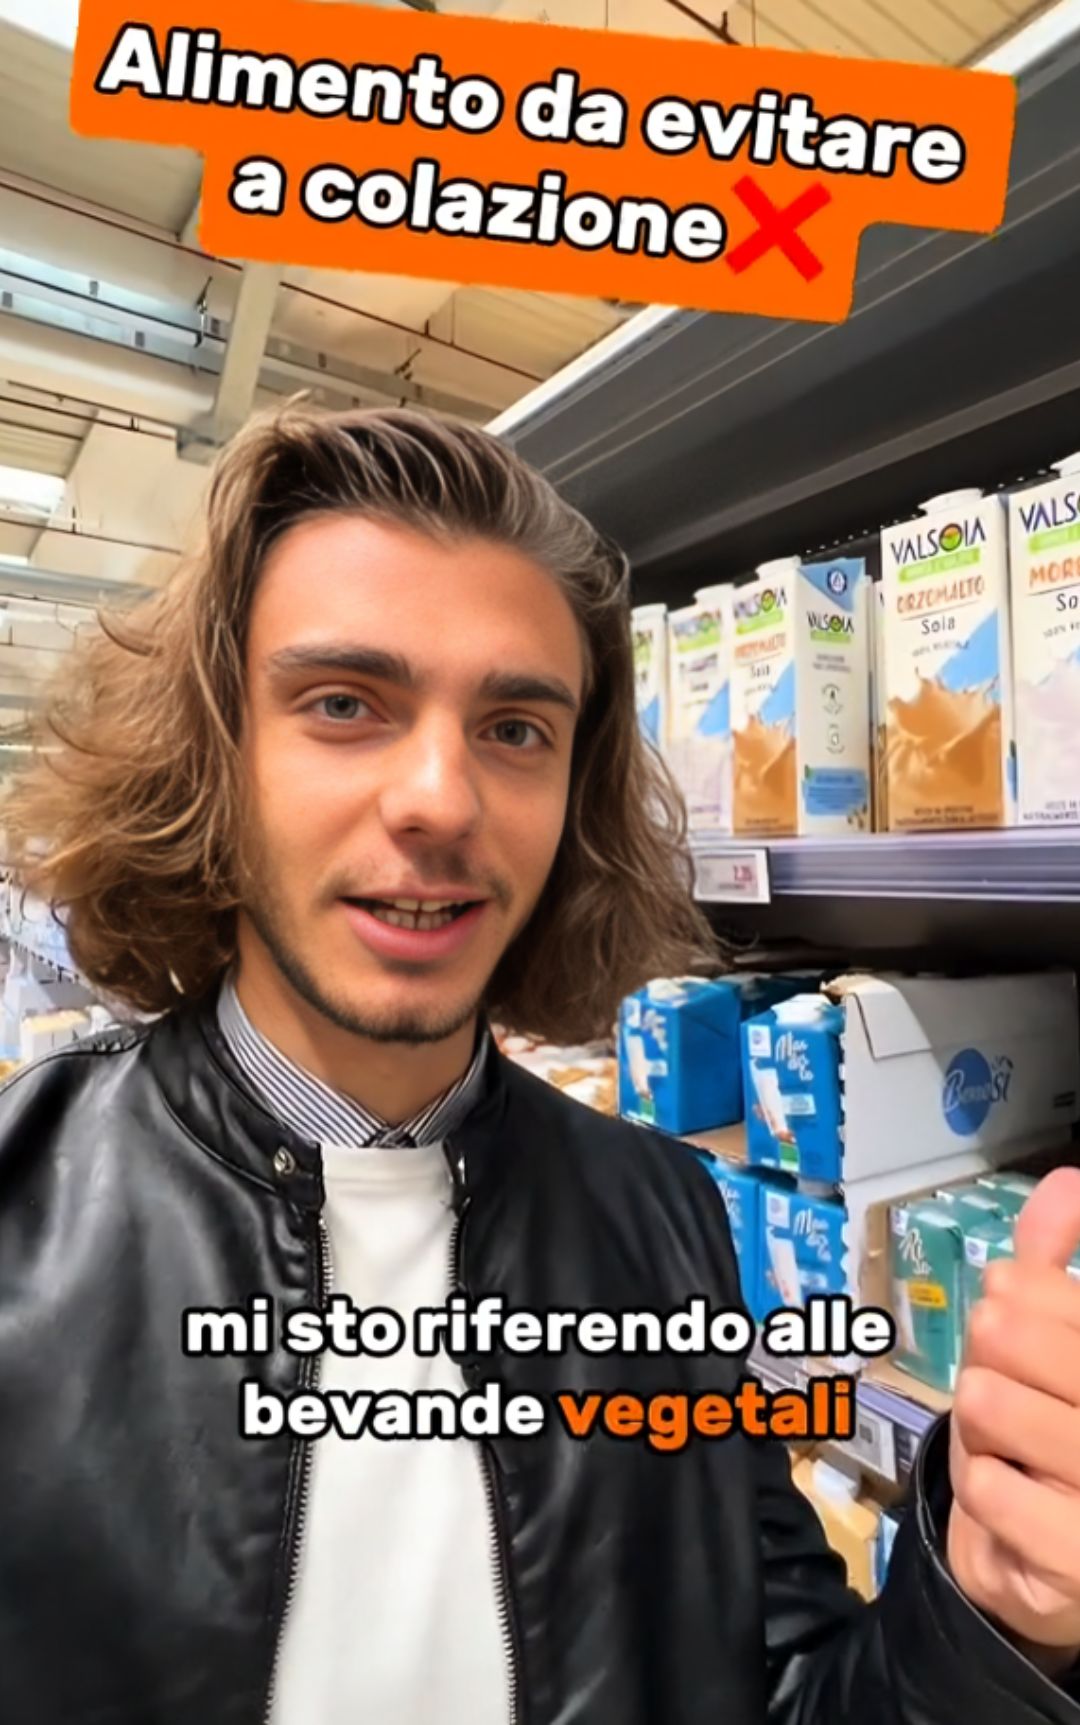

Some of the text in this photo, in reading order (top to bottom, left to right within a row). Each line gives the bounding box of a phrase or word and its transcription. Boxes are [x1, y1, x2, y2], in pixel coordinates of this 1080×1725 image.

[1019, 490, 1080, 532] VALS
[890, 516, 986, 565] VALSOIA
[896, 574, 985, 615] ORZOMALTO
[921, 616, 956, 636] Soia
